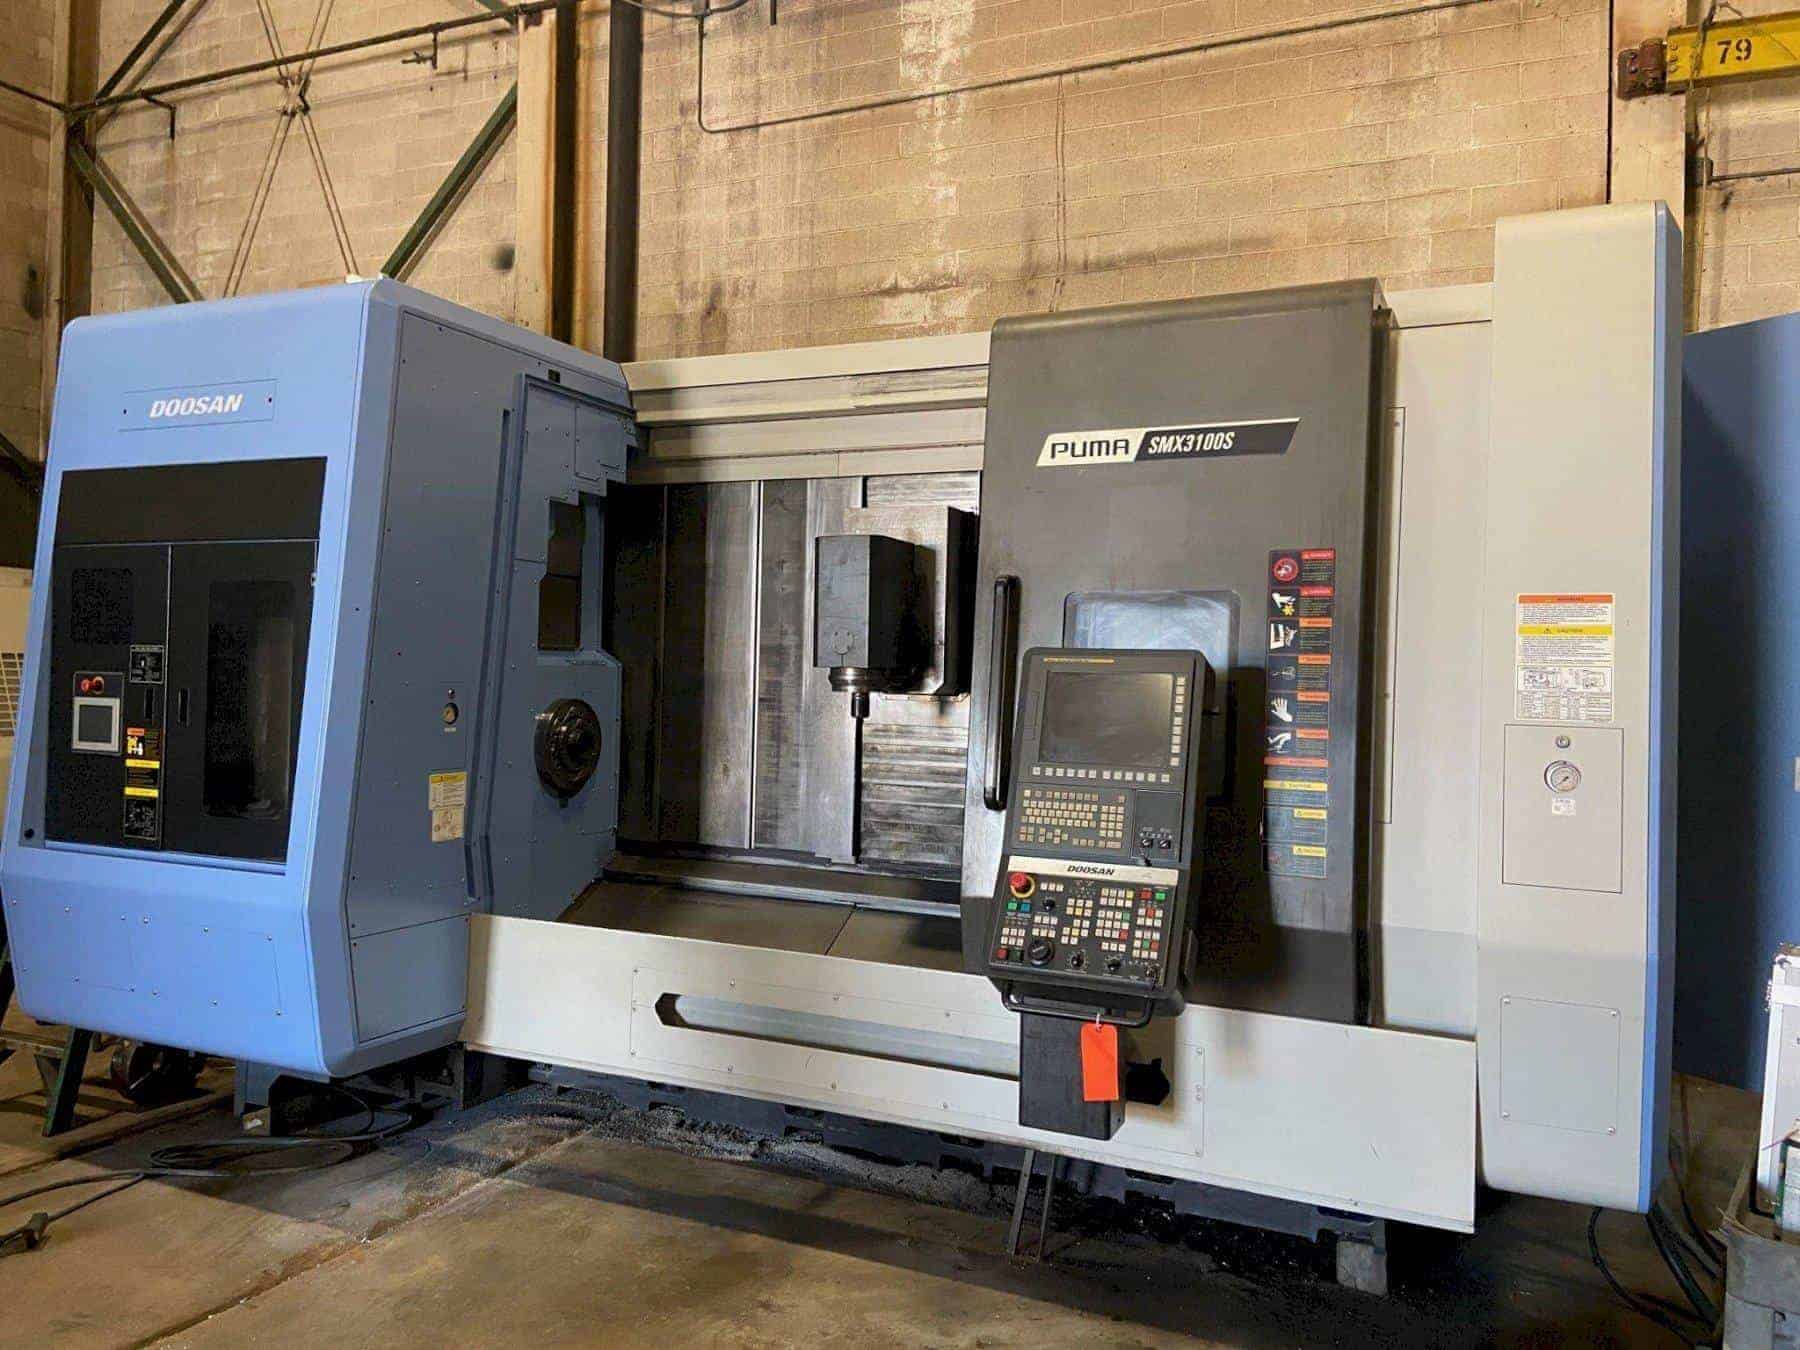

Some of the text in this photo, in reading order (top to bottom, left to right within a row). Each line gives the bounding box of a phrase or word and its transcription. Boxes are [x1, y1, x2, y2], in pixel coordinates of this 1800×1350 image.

[1717, 38, 1752, 64] 79
[150, 394, 243, 418] DOOSAN
[1050, 431, 1236, 459] PUMA SMX3100S
[1067, 865, 1115, 875] DOOSAN
